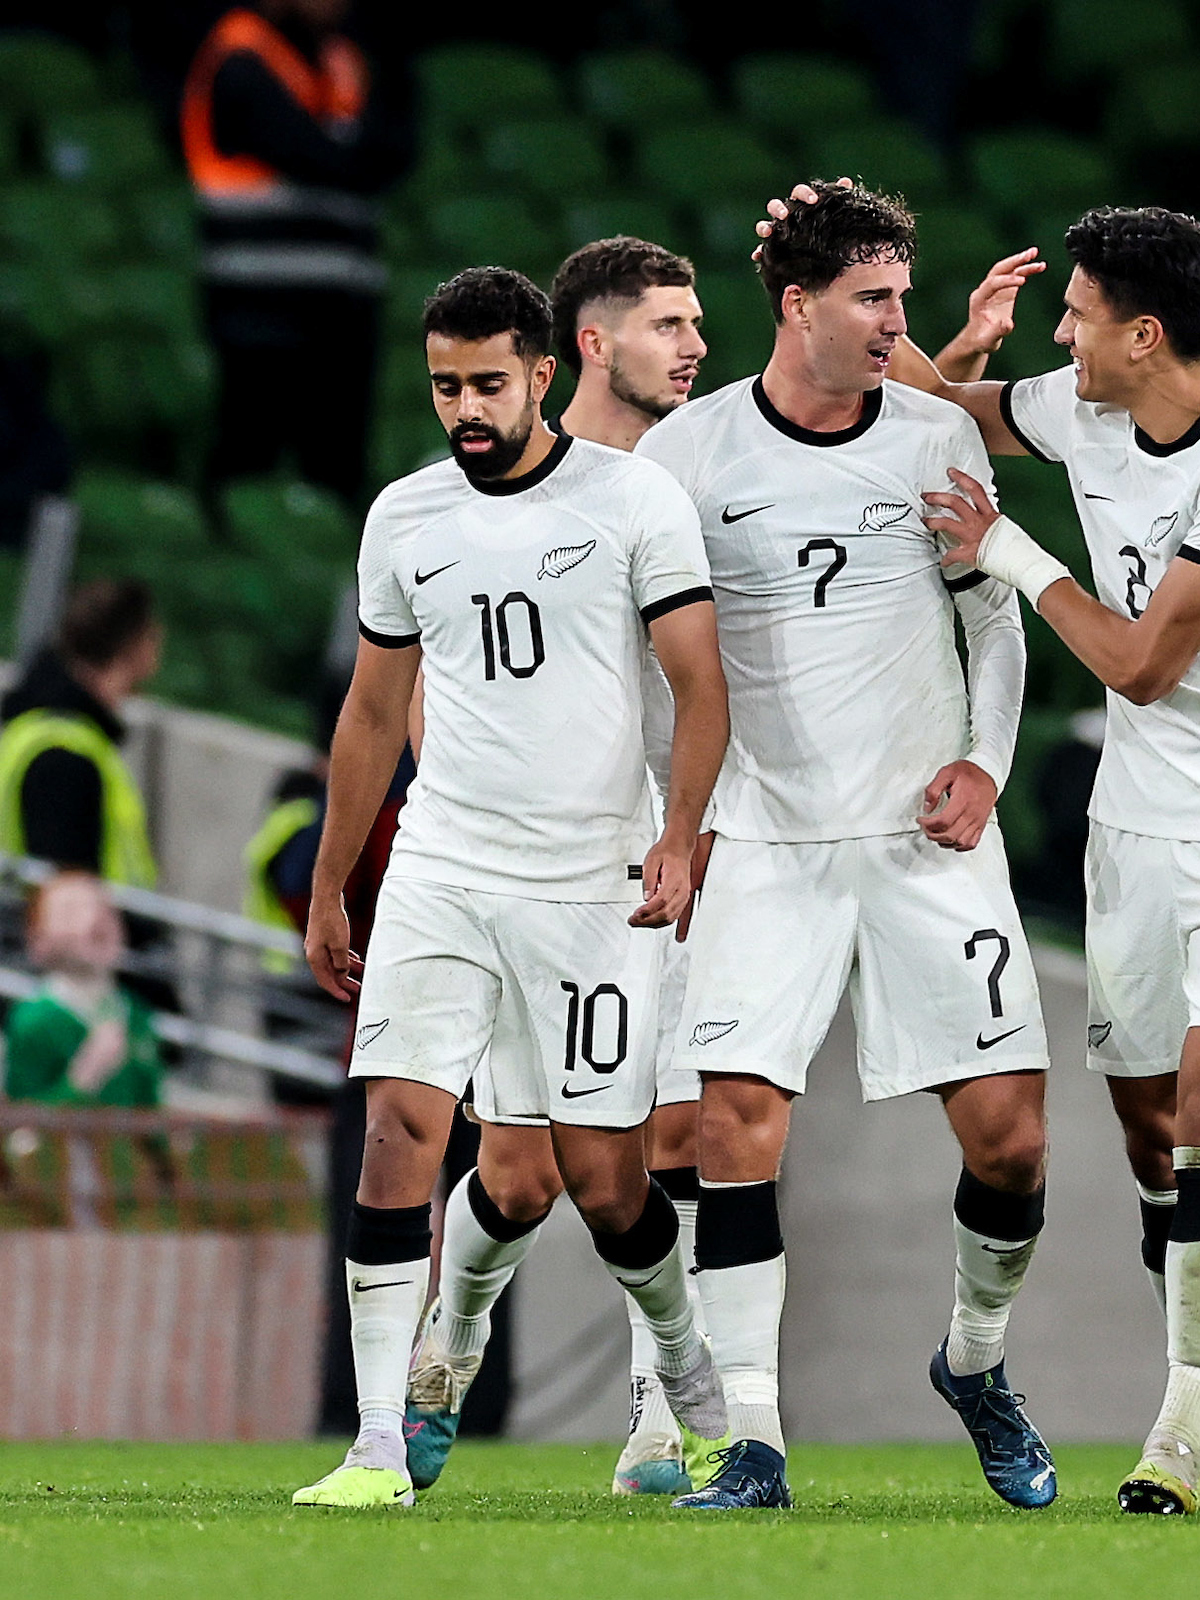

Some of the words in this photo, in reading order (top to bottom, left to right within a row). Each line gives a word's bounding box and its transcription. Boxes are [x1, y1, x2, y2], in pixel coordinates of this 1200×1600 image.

[798, 539, 848, 608] 7
[472, 592, 546, 681] 10
[964, 929, 1011, 1018] 7
[561, 981, 628, 1074] 10
